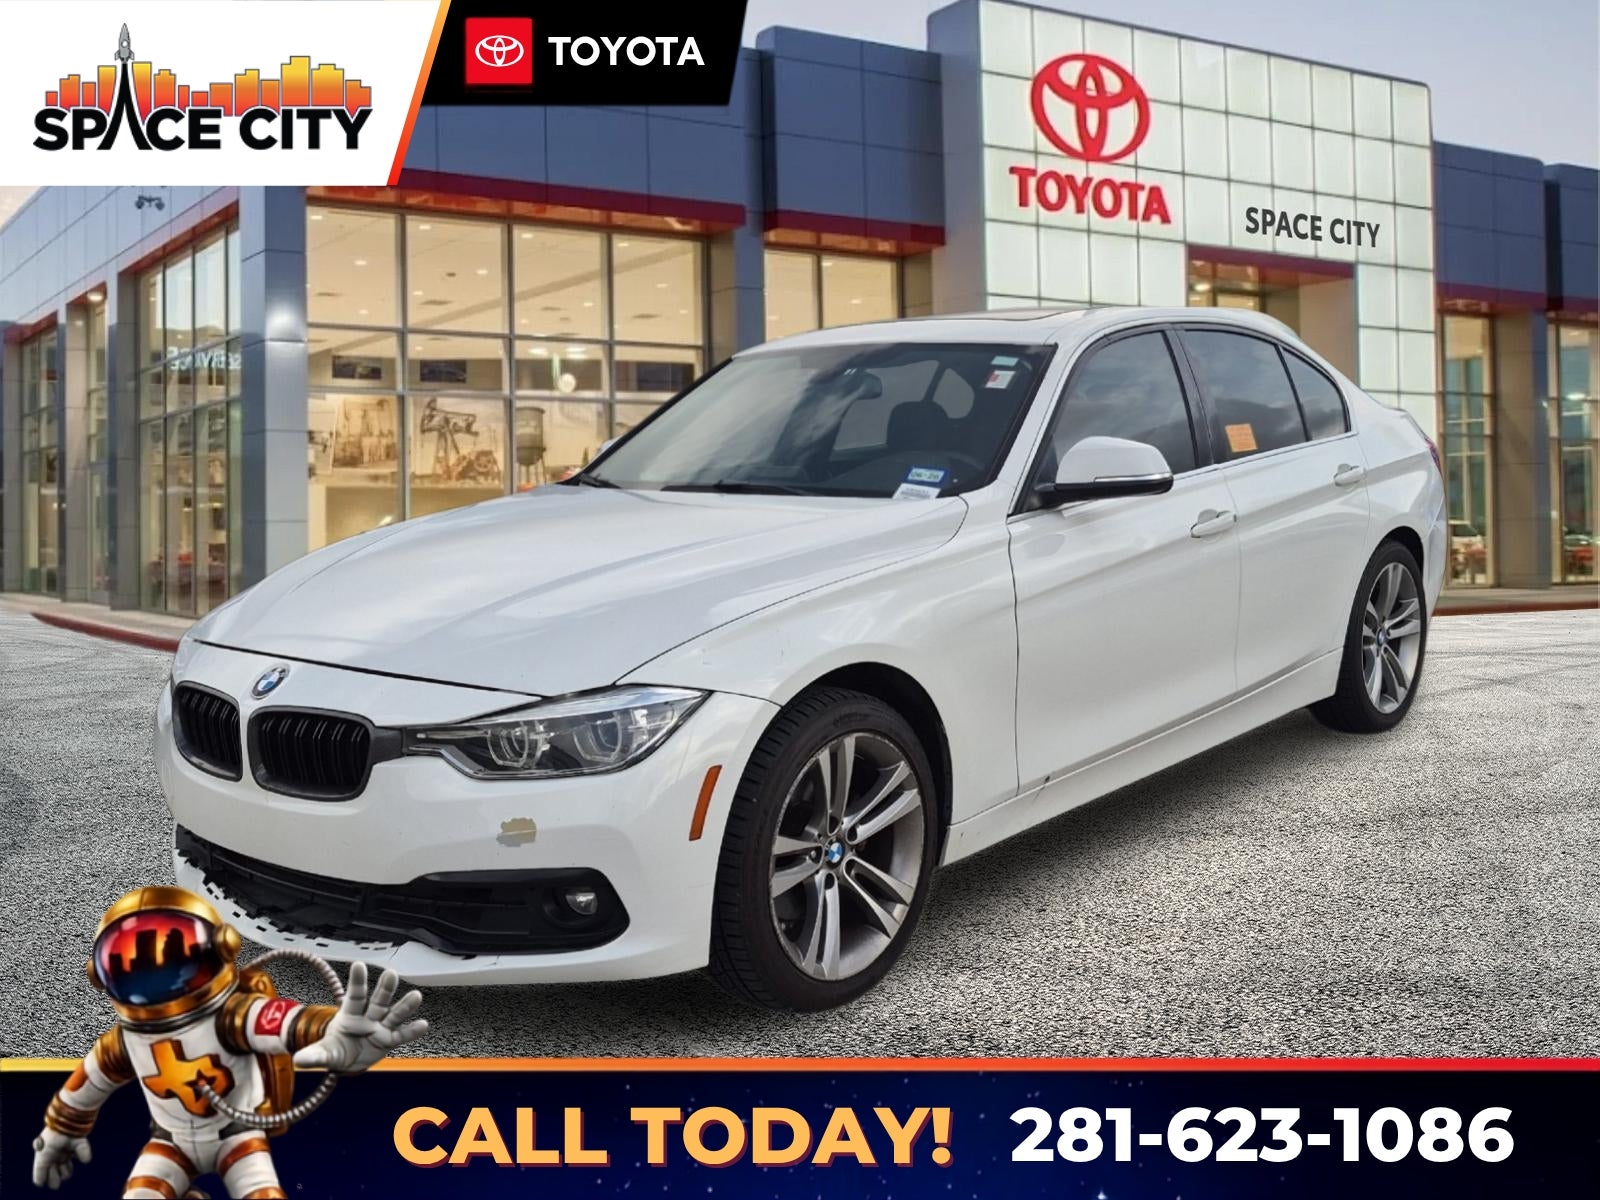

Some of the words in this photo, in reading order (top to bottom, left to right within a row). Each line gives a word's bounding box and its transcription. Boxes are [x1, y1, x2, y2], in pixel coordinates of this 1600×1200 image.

[1009, 166, 1171, 224] TOYOTA
[1246, 206, 1322, 241] SPACE
[1329, 218, 1380, 248] CITY
